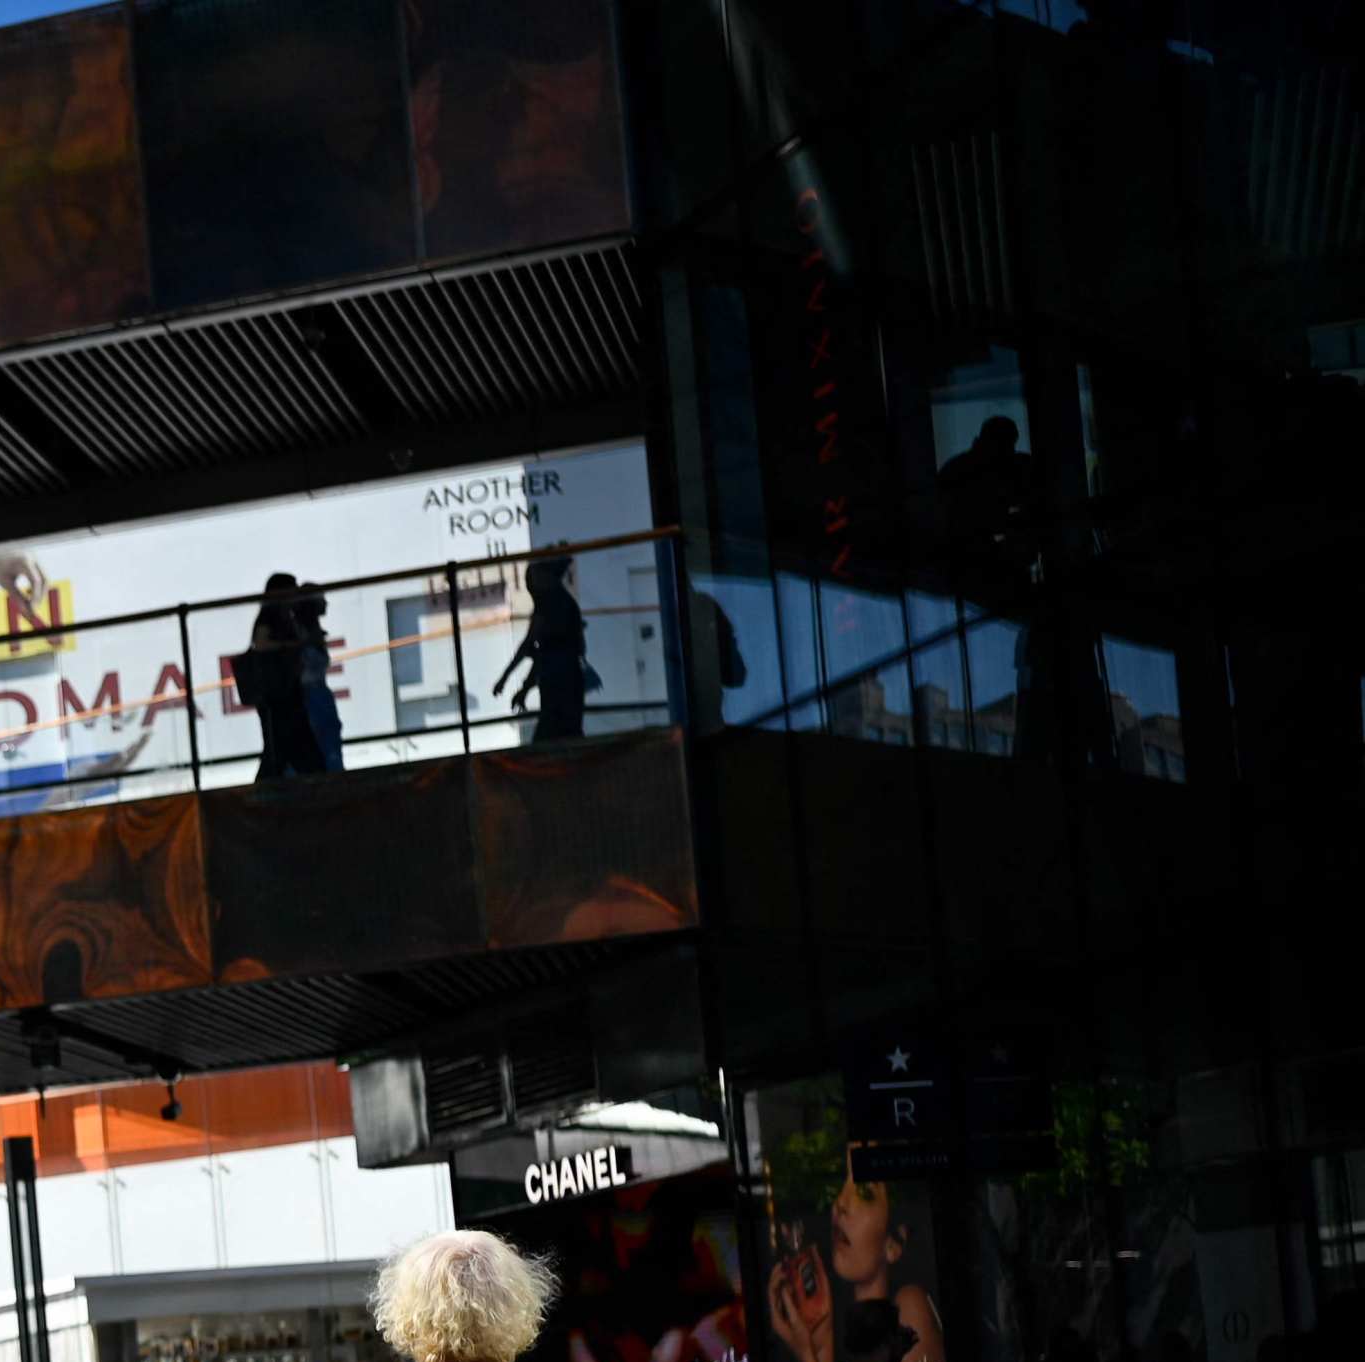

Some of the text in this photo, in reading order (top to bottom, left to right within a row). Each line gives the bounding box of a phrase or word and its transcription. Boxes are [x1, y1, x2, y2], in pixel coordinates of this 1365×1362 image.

[423, 470, 565, 511] ANOTHER
[449, 503, 541, 536] ROOM
[893, 1096, 918, 1128] R
[524, 1144, 627, 1204] CHANEL
